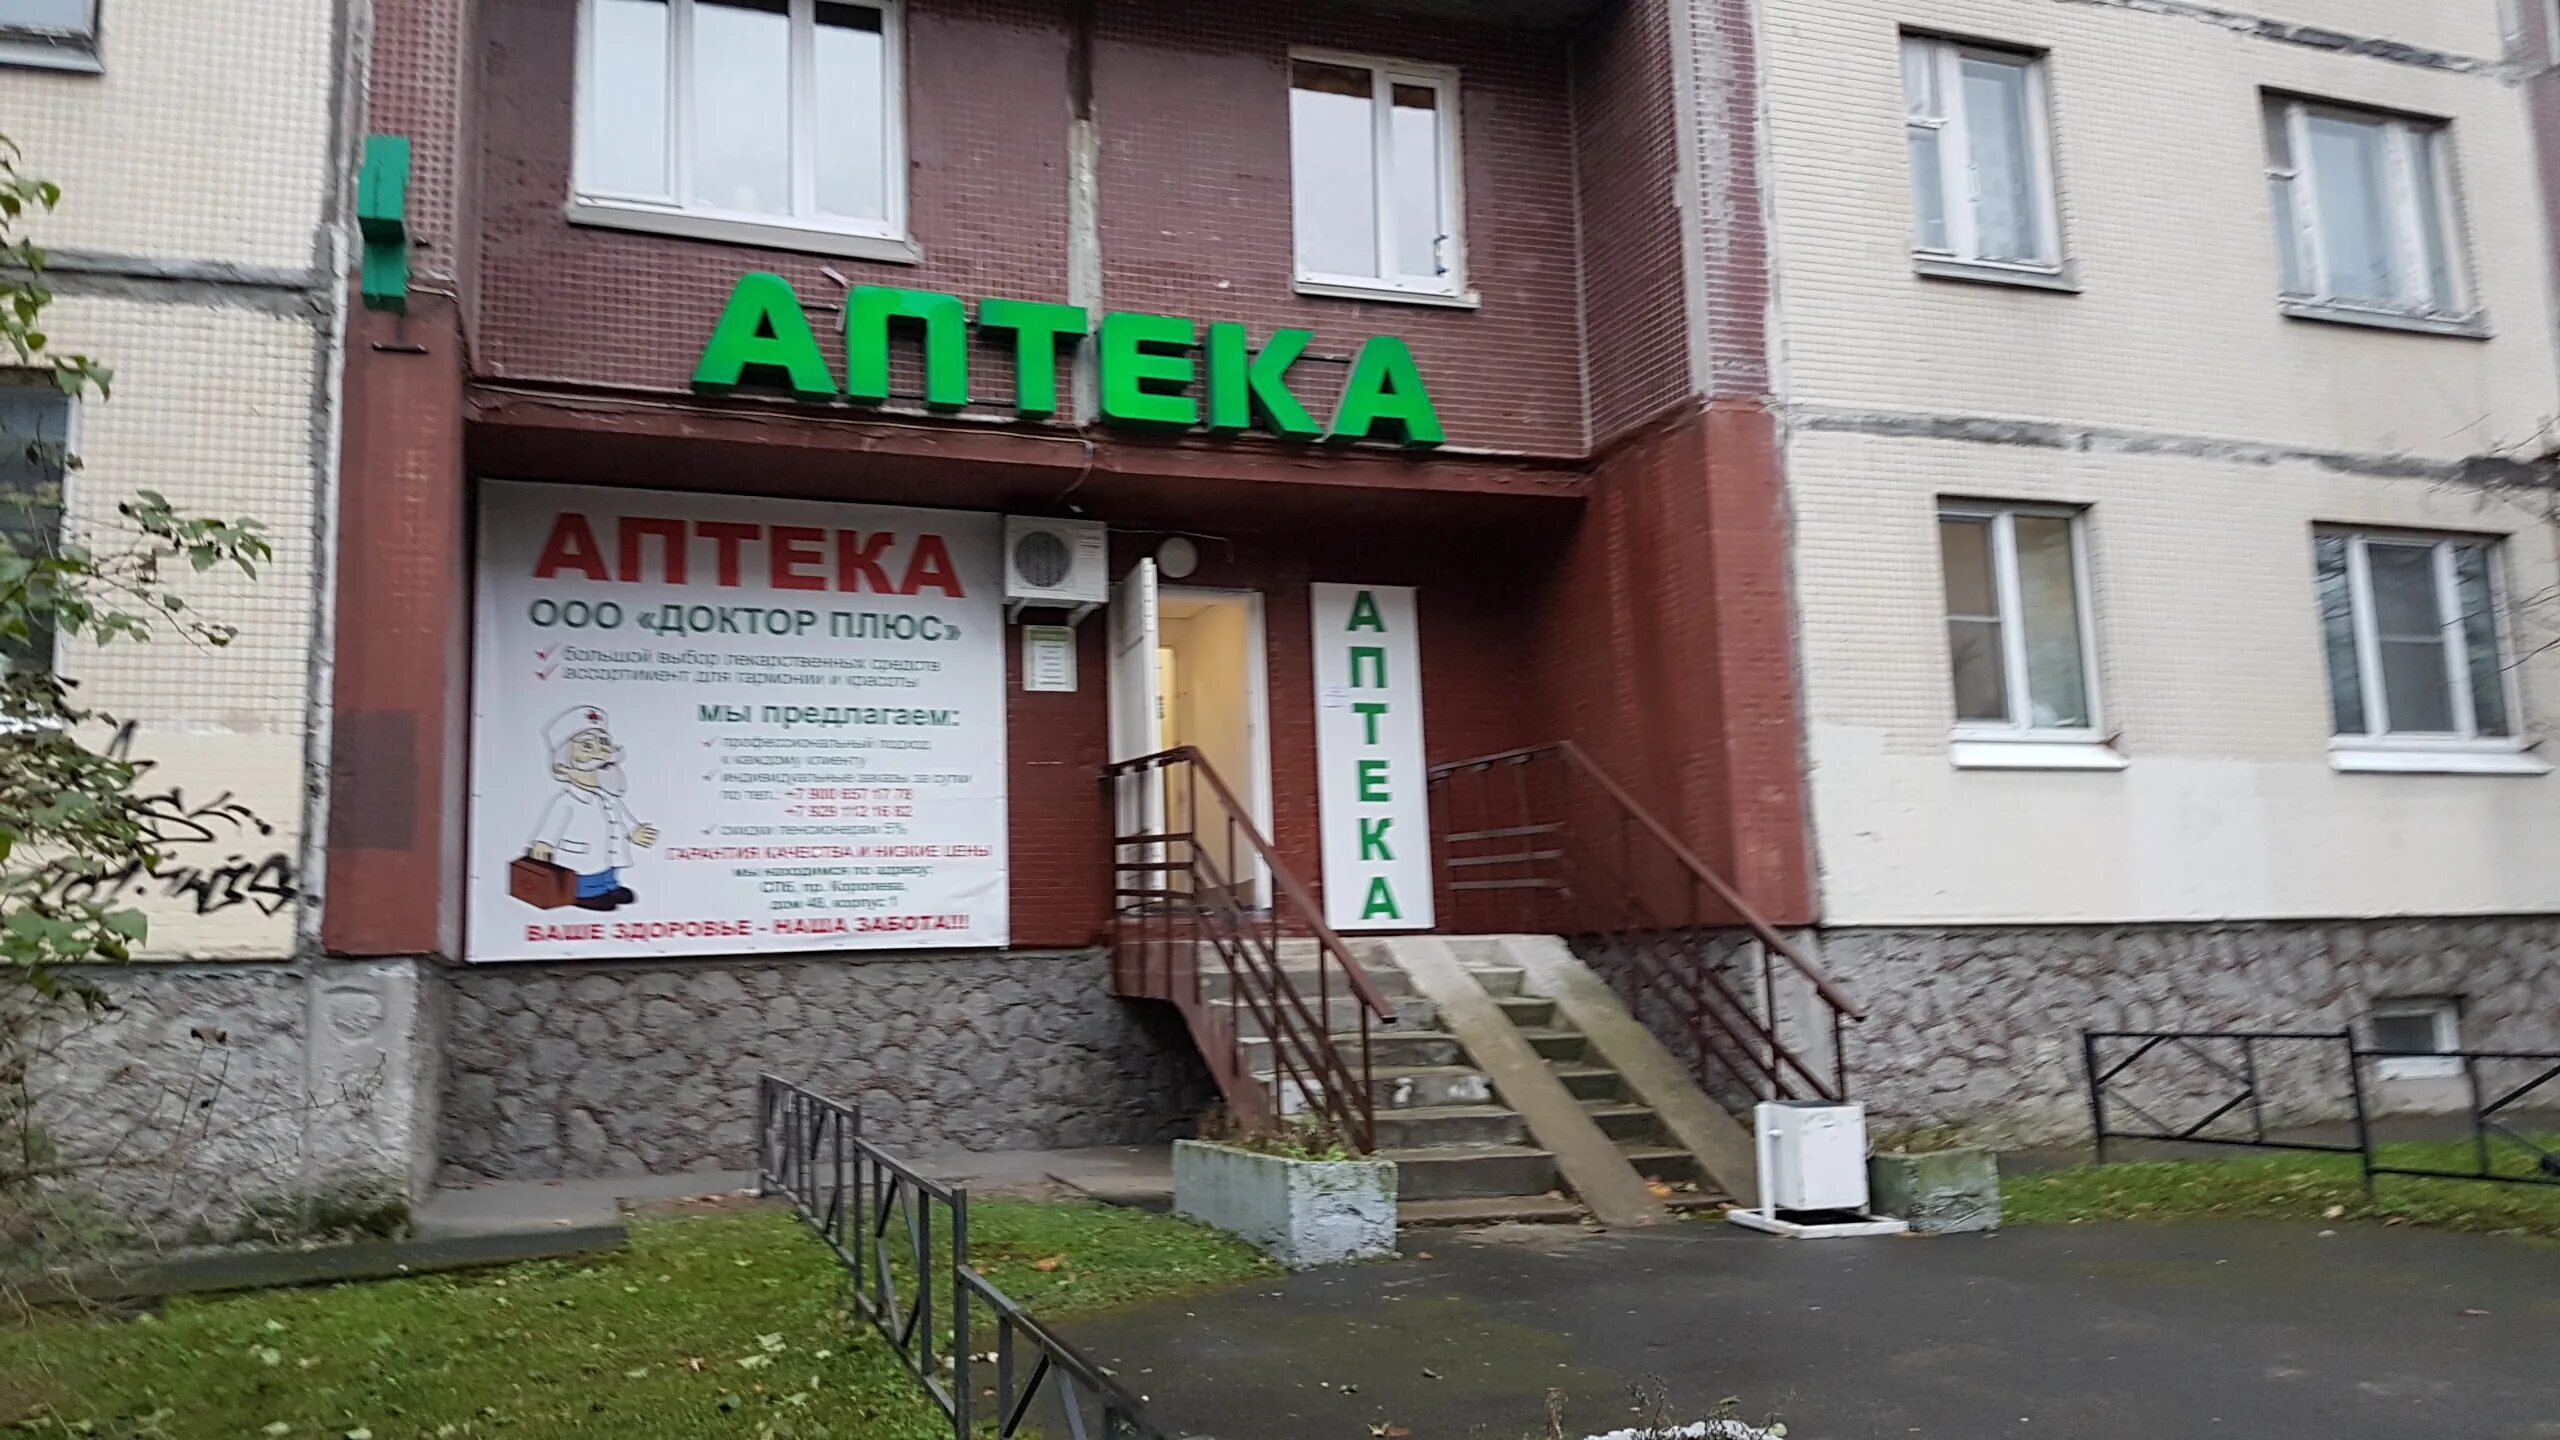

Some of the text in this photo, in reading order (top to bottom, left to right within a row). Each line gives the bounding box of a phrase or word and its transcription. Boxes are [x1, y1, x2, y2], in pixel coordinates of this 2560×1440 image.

[691, 271, 1446, 449] АПТЕКА
[533, 513, 966, 598] АПТЕКА
[530, 599, 962, 641] ООО «ДОКТОР ПЛЮС»
[658, 649, 720, 668] выбор
[723, 654, 867, 671] лекарственных
[871, 658, 941, 673] средств
[562, 667, 919, 689] ассортимент для гармонии и красоты
[697, 704, 961, 729] мы предлагаем:
[722, 736, 931, 751] профессиональный подход
[735, 755, 801, 768] каждому
[806, 756, 865, 768] клиенту
[1346, 590, 1402, 920] АПТЕКА
[721, 773, 971, 786] индивидуальные заказы за сутки
[720, 790, 742, 801] по
[784, 787, 804, 800] +7
[784, 805, 804, 818] +7
[665, 845, 992, 860] ГАРАНТИЯ КАЧЕСТВА И НИЗКИЕ ЦЕНЫ
[732, 867, 760, 877] мы
[765, 867, 847, 877] находимся
[853, 867, 871, 876] по
[768, 900, 803, 911] дом
[832, 898, 886, 911] корпус
[526, 924, 605, 942] ВАШЕ
[613, 919, 752, 942] ЗДОРОВЬЕ
[772, 917, 848, 935] НАША
[855, 914, 970, 934] ЗАБОТА!!!
